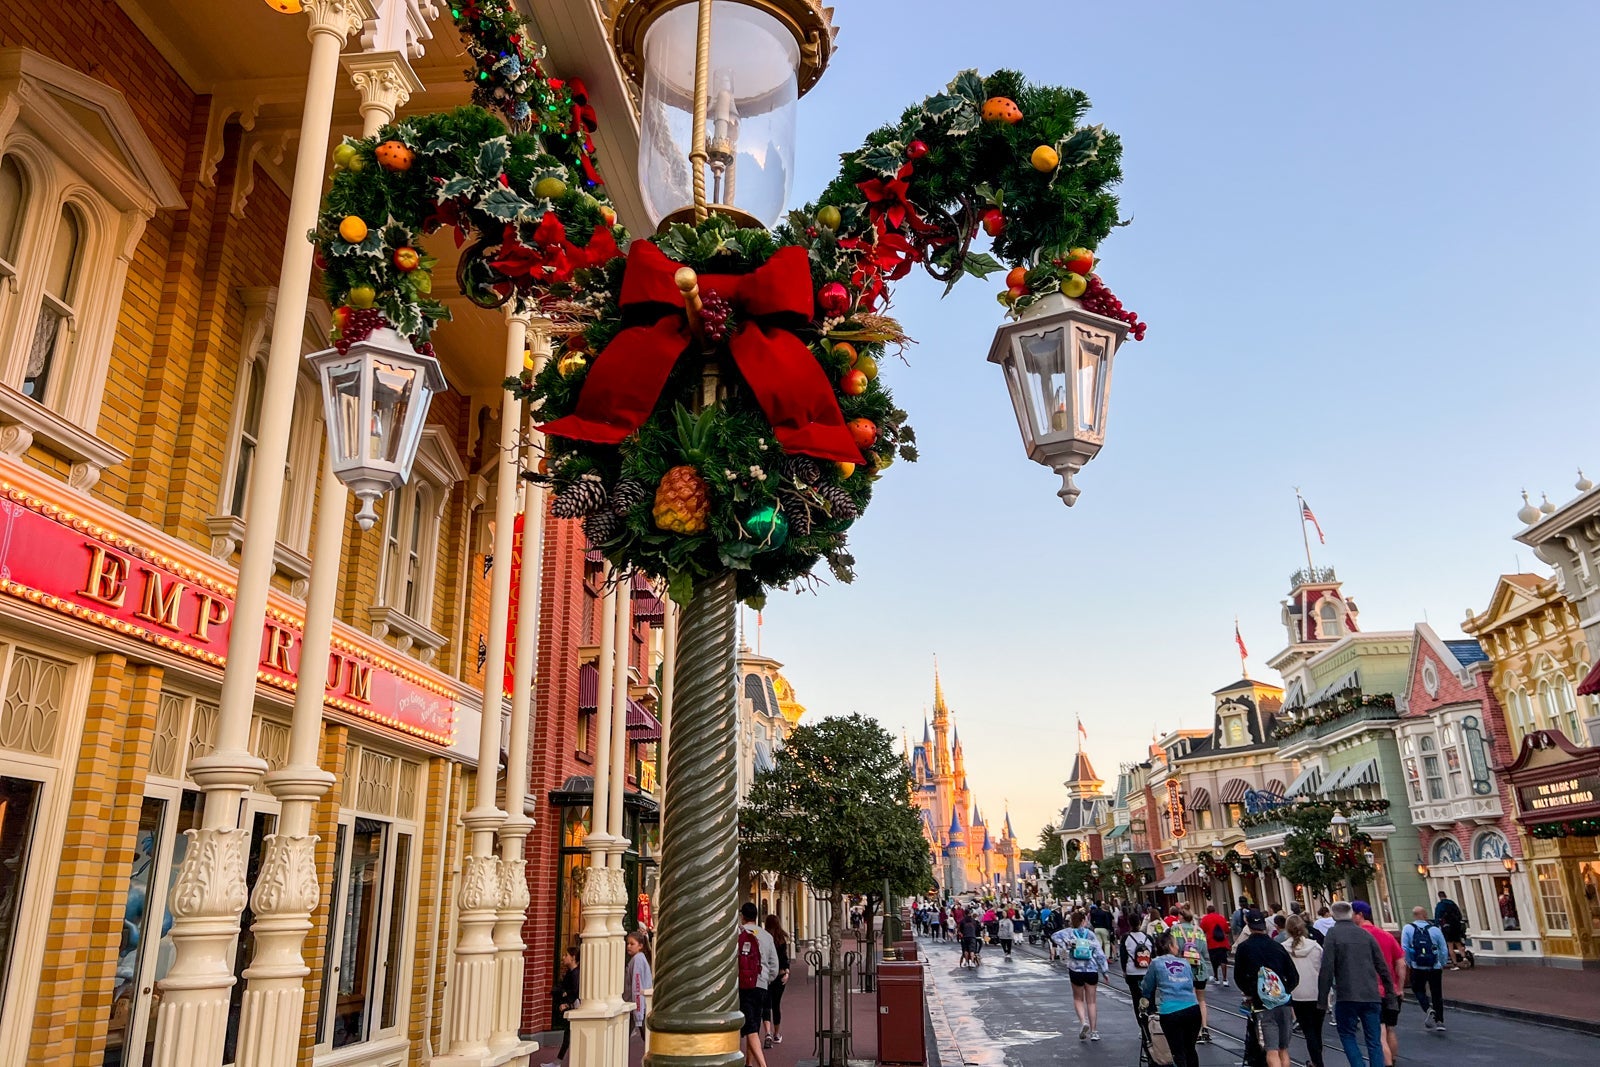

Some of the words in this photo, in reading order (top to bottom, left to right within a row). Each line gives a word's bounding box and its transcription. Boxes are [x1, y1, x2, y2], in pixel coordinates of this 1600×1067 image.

[76, 541, 374, 705] EMPRUM
[1538, 784, 1550, 796] THE
[1549, 781, 1570, 794] MAGIC
[1569, 779, 1579, 790] OF
[1532, 797, 1549, 809] WALT
[1548, 794, 1571, 807] DISNEY
[1569, 790, 1594, 804] WORLD
